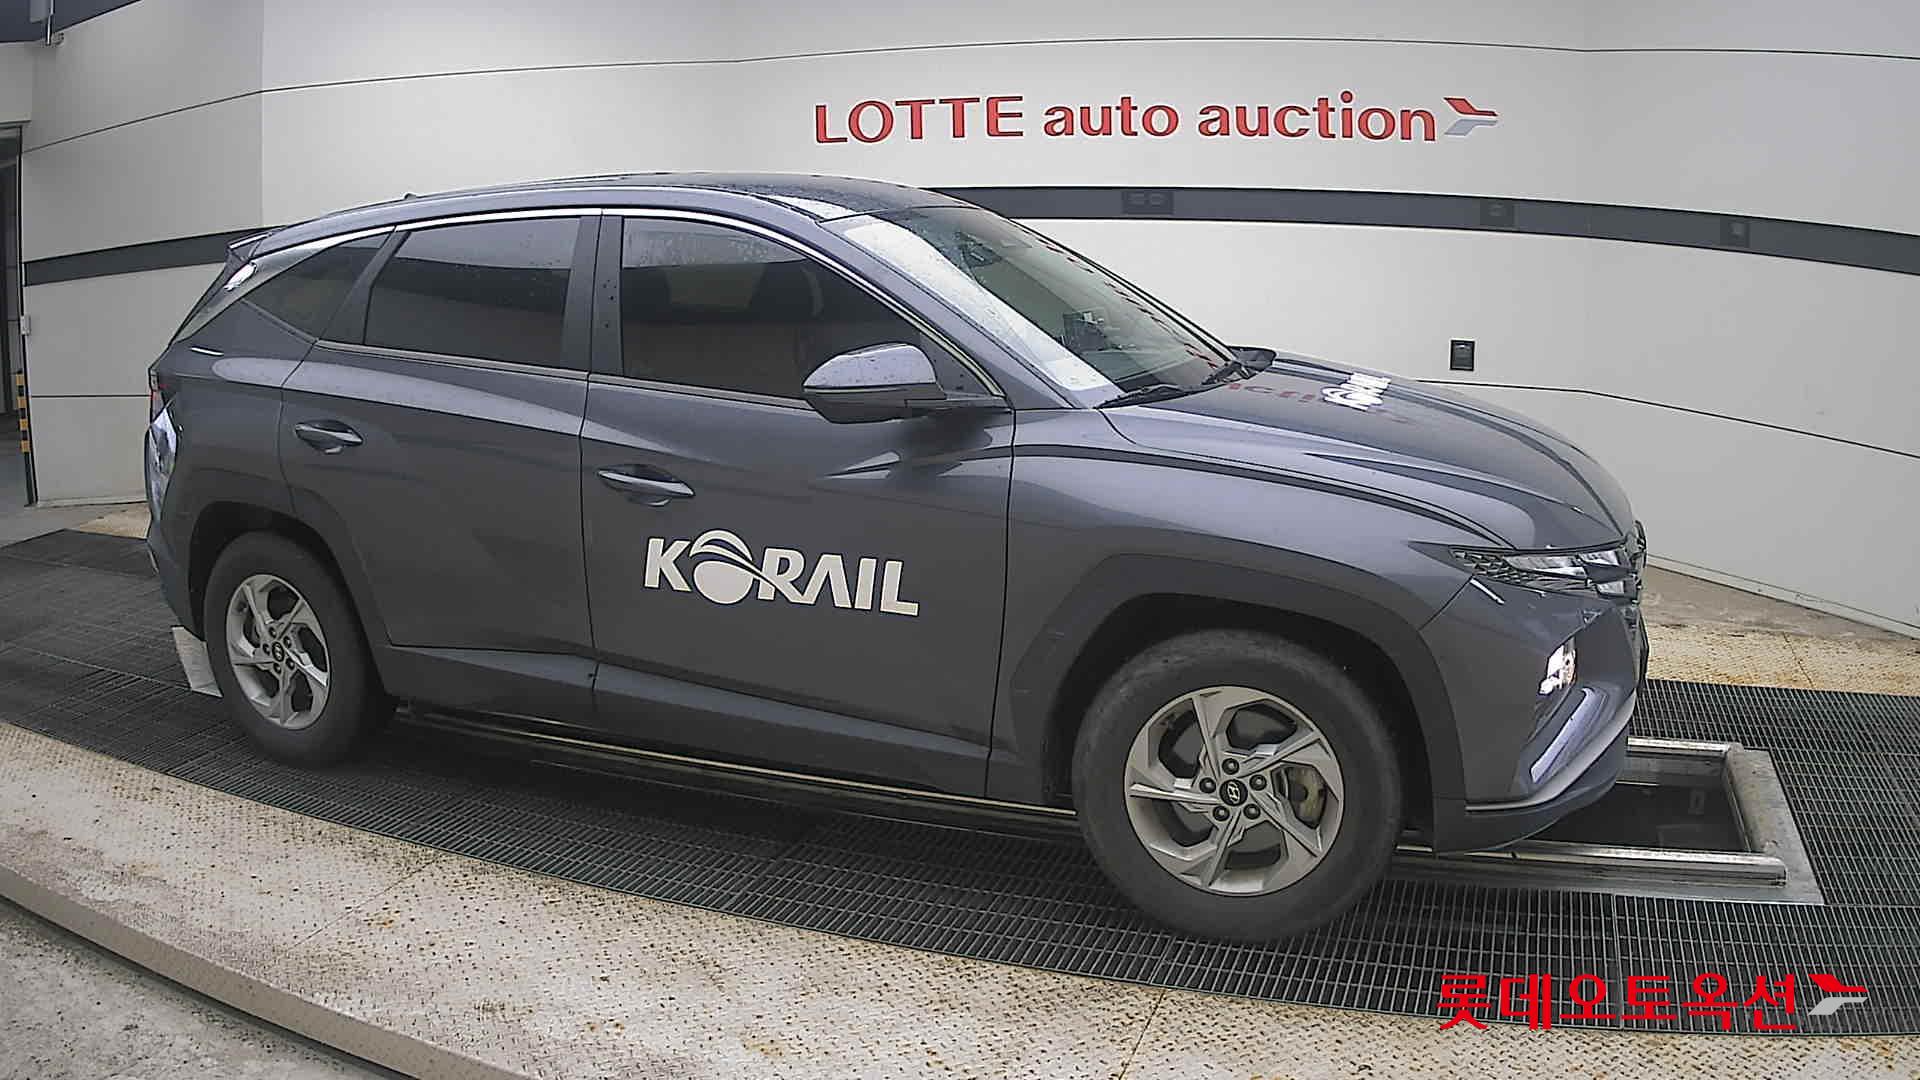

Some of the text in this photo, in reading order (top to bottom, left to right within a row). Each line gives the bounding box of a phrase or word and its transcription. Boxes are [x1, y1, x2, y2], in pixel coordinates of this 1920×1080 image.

[815, 90, 1437, 144] LOTTE auto auction
[644, 529, 919, 616] KORAIL
